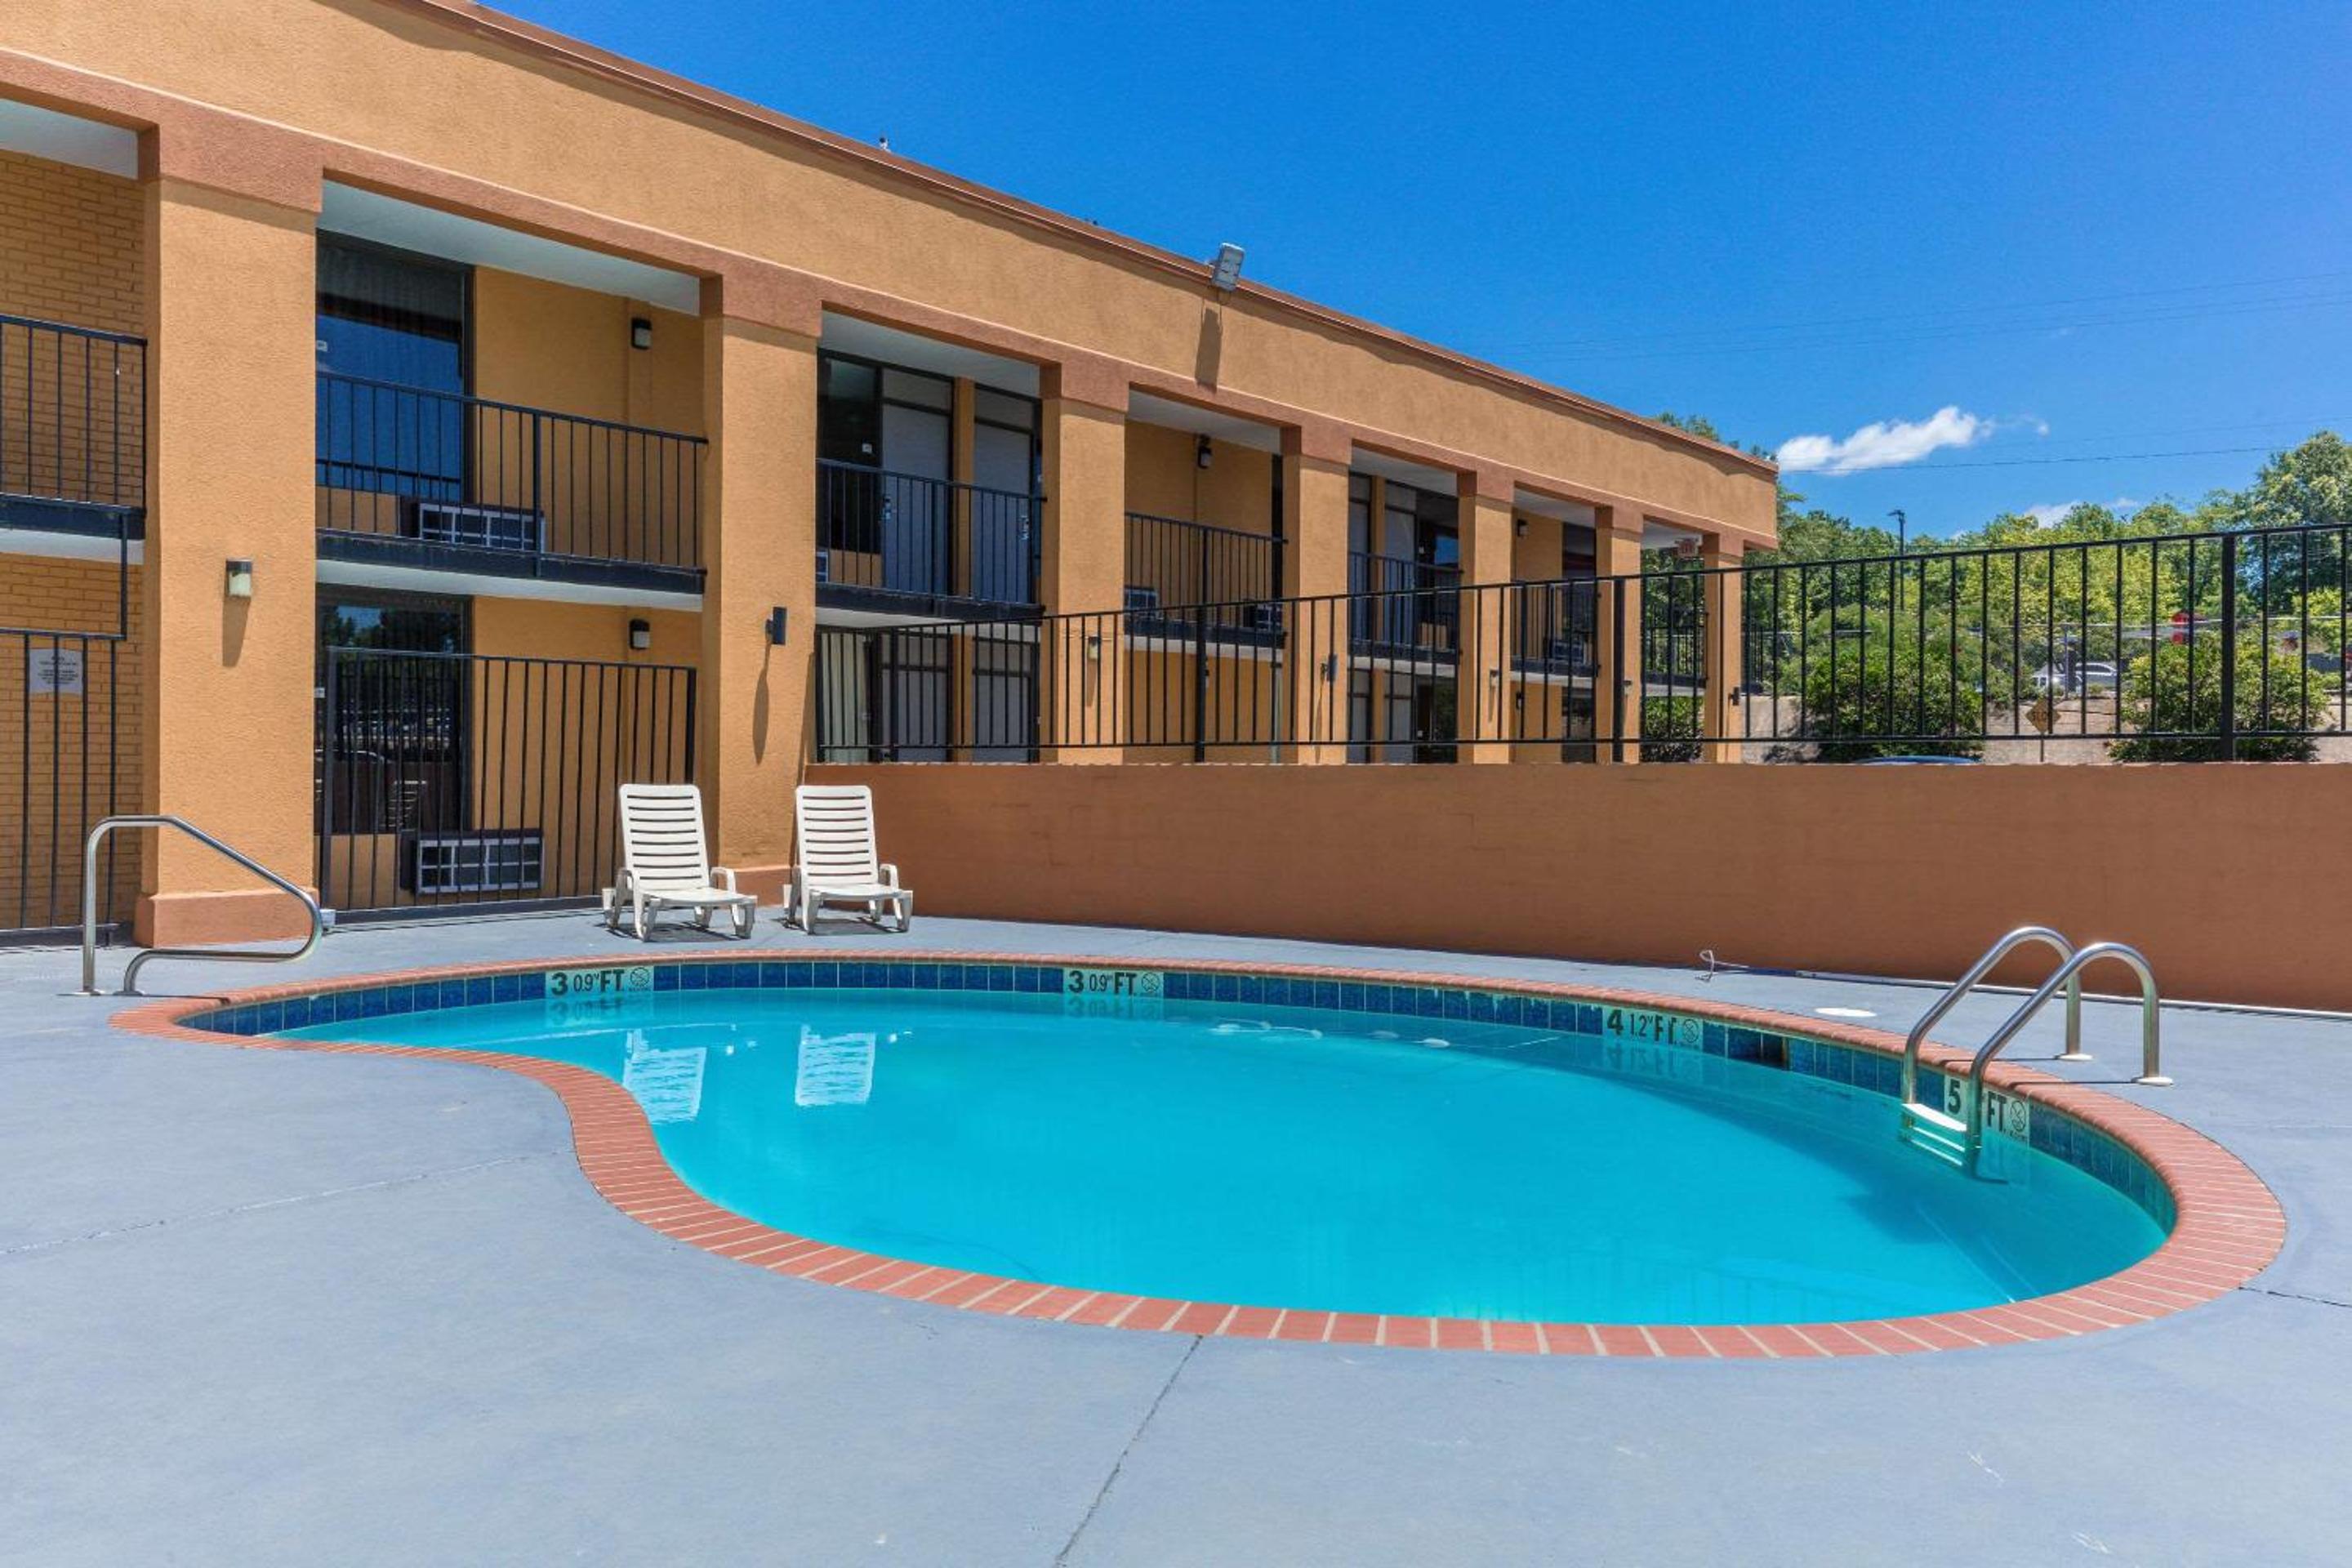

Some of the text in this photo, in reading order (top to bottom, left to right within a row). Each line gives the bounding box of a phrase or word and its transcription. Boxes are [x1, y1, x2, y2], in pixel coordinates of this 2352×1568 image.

[551, 972, 568, 996] 3
[1068, 970, 1084, 993] 3
[1606, 1009, 1624, 1036] 4
[1948, 1079, 1962, 1115] 5
